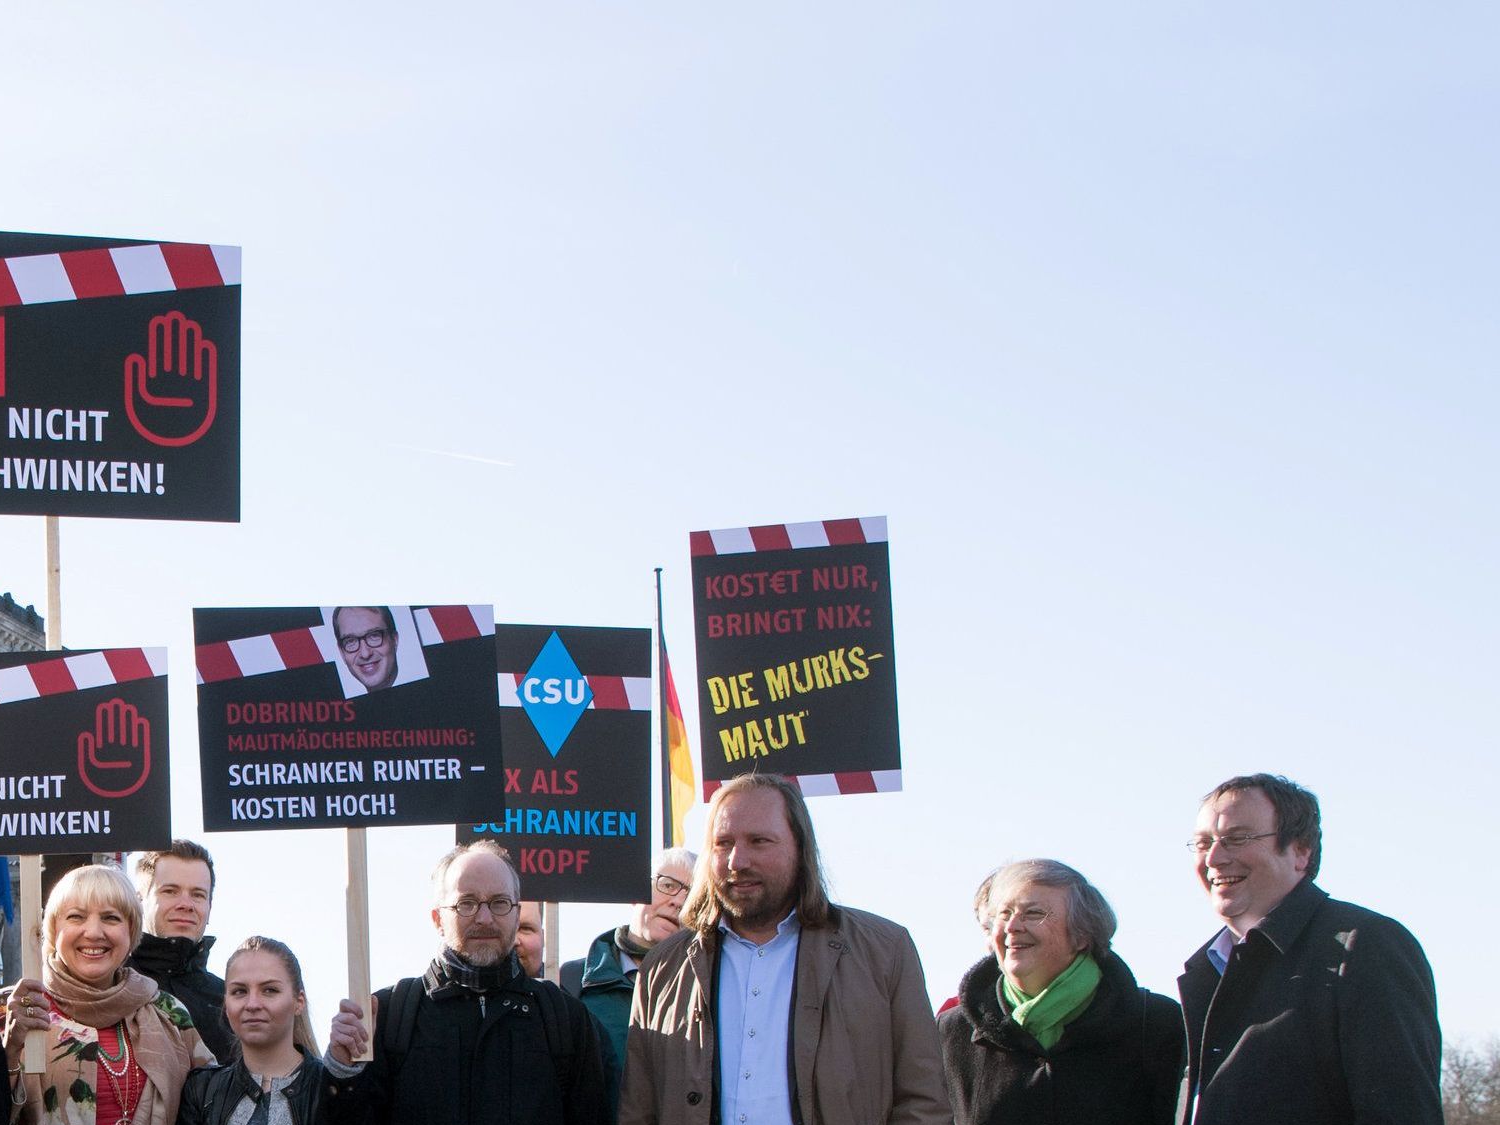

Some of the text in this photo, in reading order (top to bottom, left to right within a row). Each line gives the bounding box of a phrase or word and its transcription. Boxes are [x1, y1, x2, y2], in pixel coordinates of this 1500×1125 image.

[8, 406, 109, 442] NICHT
[812, 564, 879, 593] NUR,
[707, 604, 872, 639] BRINGT NIX:
[524, 677, 585, 705] CSU
[707, 646, 884, 715] DIE MURKS-
[227, 700, 357, 726] DOBRINDTS
[228, 728, 476, 752] MAUTMÄDCHENRECHNUNG:
[719, 709, 809, 763] MAUT
[228, 761, 364, 786] SCHRANKEN
[373, 758, 462, 782] RUNTER
[530, 769, 579, 795] ALS
[231, 794, 396, 820] KOSTEN HOCH!
[520, 848, 590, 874] KOPF
